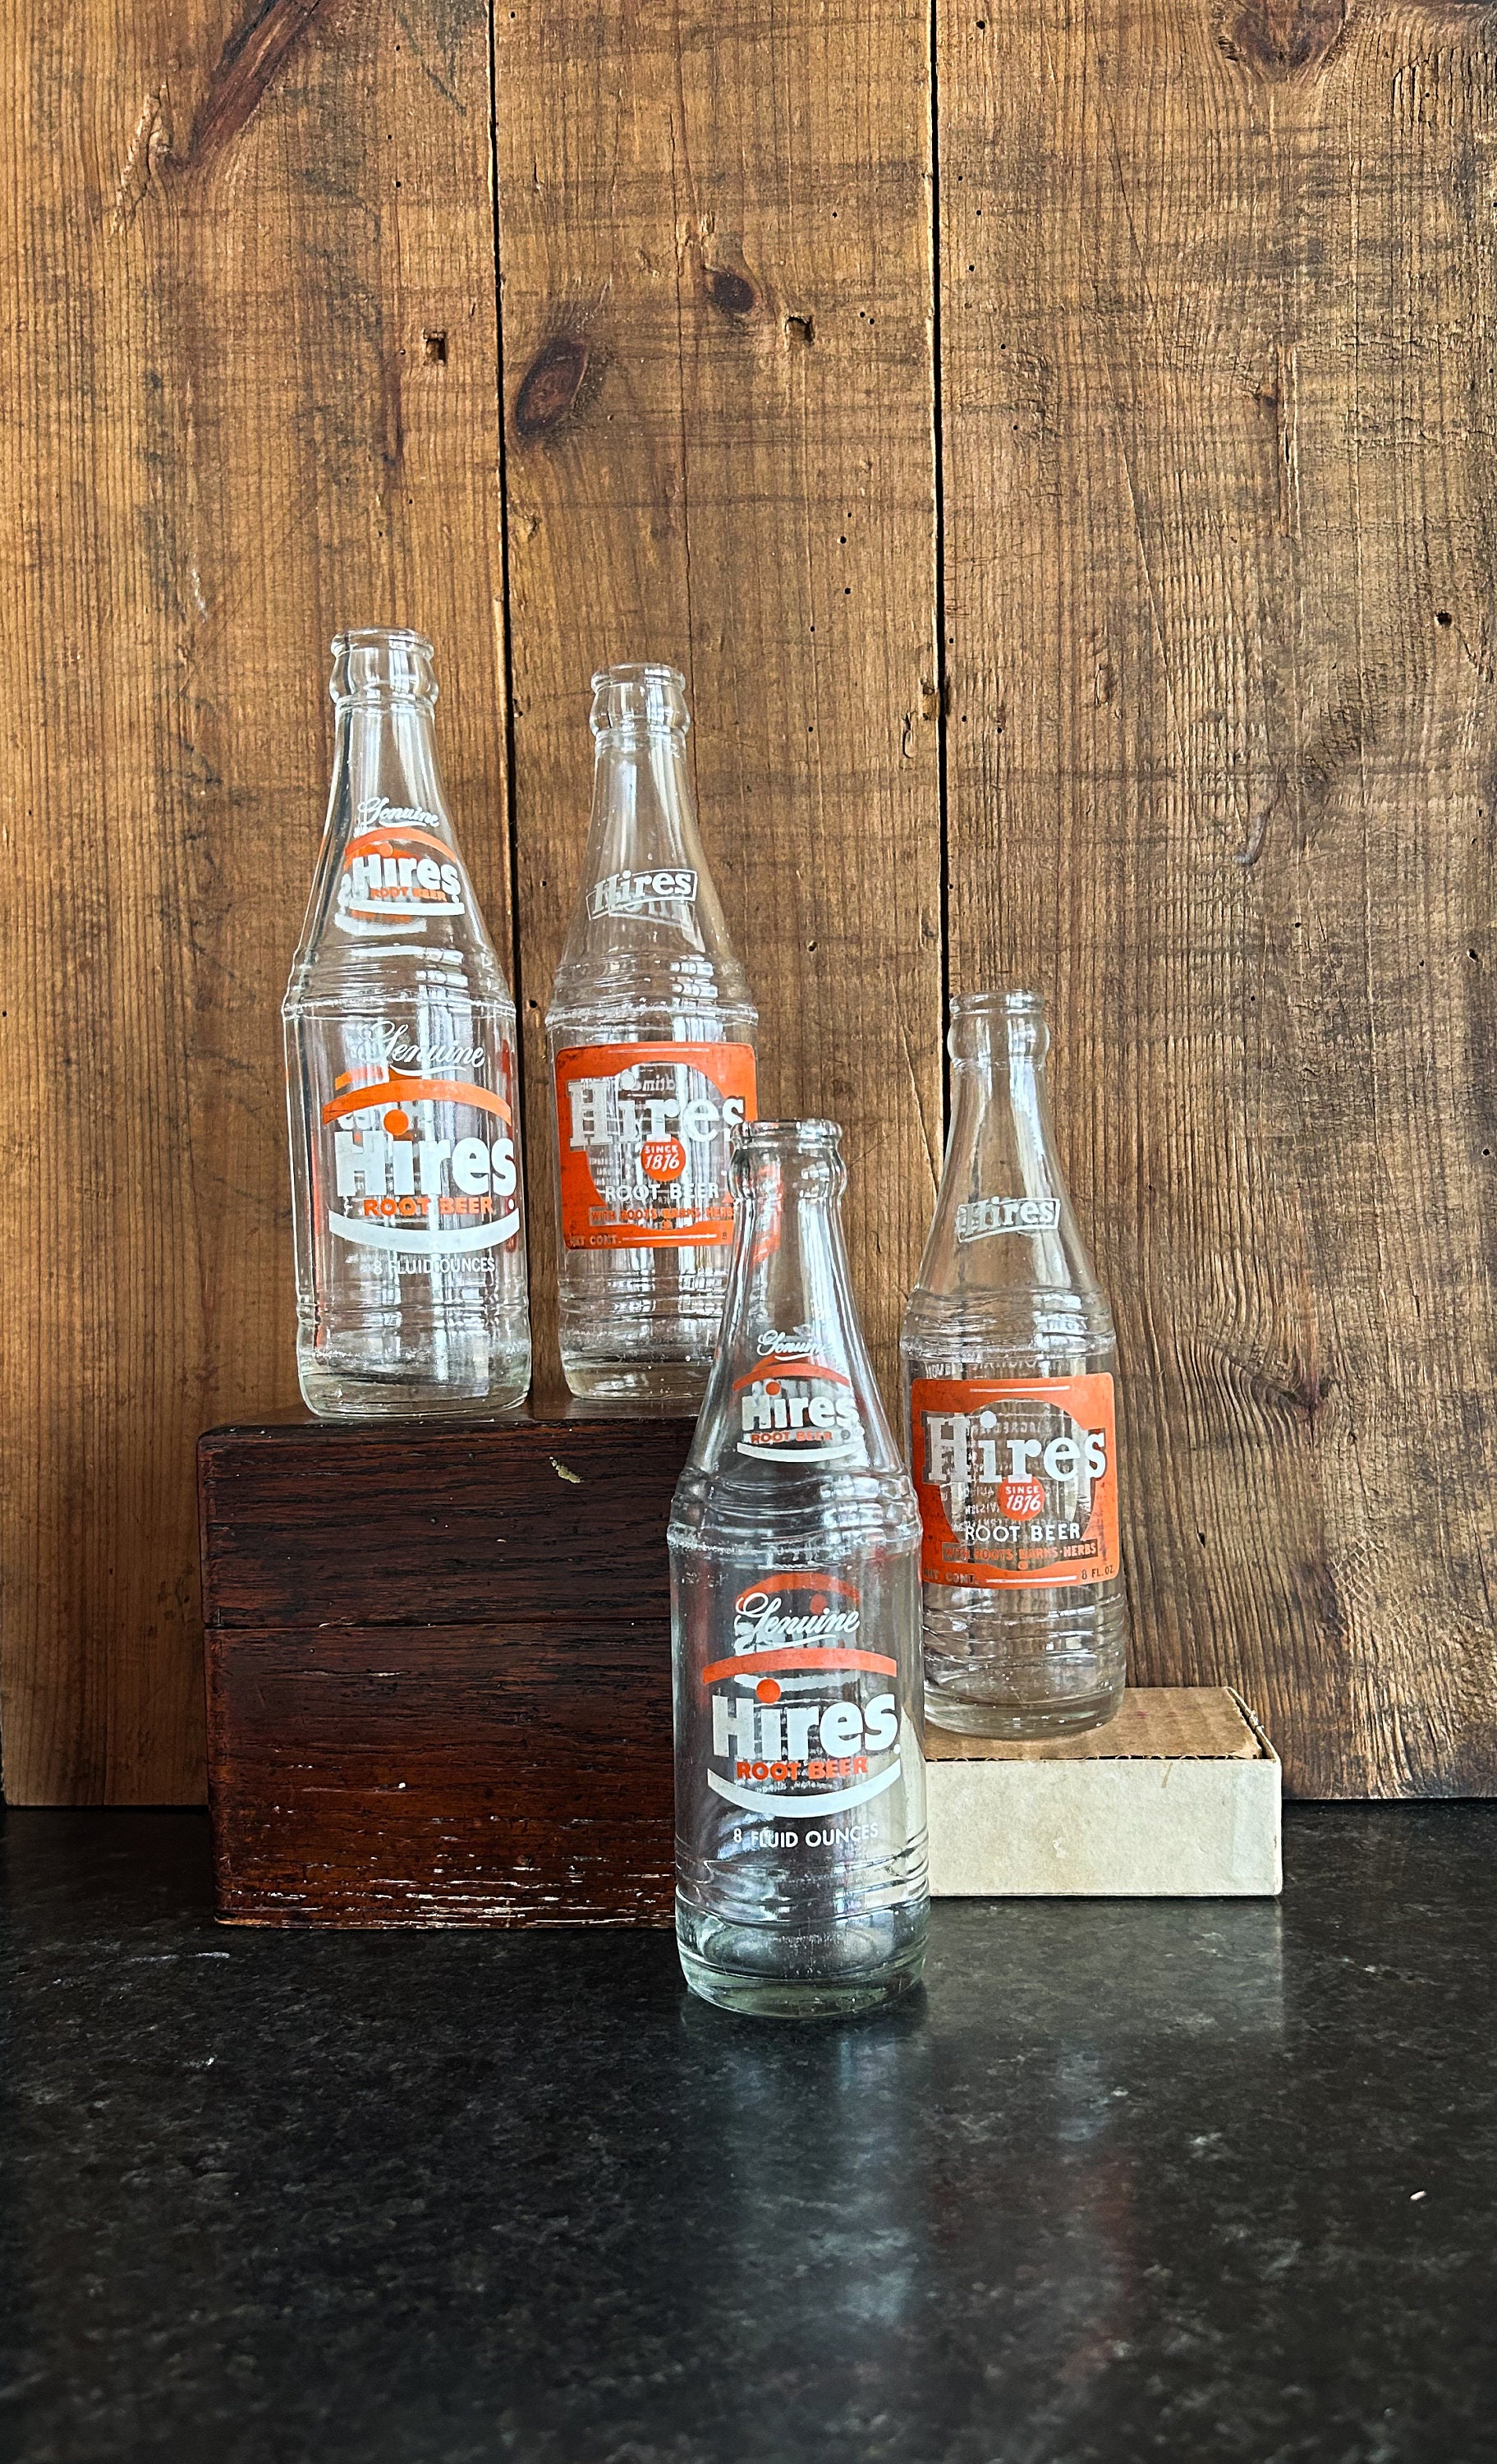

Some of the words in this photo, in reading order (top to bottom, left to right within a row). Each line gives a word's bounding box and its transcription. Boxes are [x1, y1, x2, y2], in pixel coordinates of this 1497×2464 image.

[358, 797, 439, 827] Genuine
[352, 843, 461, 895] Hires
[370, 887, 409, 899] ROOT
[412, 888, 448, 902] BEER
[592, 870, 691, 913] Hires
[365, 1020, 485, 1076] Genuine
[568, 1072, 744, 1147] Hires
[334, 1109, 517, 1197] Hires
[644, 1144, 678, 1154] SINCE
[645, 1153, 680, 1172] 1876
[605, 1184, 660, 1203] ROOT
[670, 1182, 719, 1200] BEER
[363, 1198, 431, 1216] ROOT
[439, 1198, 494, 1215] BEER
[591, 1209, 615, 1221] WITH
[708, 1206, 735, 1217] HERB
[966, 1197, 1054, 1234] Hires
[388, 1260, 434, 1275] FLUID
[440, 1257, 495, 1273] OUNCES
[742, 1381, 860, 1431] Hires
[751, 1432, 790, 1444] ROOT
[796, 1431, 833, 1441] BEER
[927, 1411, 1106, 1483] Hires
[1005, 1486, 1040, 1495] SINCE
[1007, 1495, 1041, 1515] 1876
[965, 1525, 1020, 1542] ROOT
[1031, 1523, 1080, 1541] BEER
[945, 1548, 969, 1559] WITH
[1063, 1542, 1097, 1556] HERBS
[734, 1592, 861, 1647] Genuine
[712, 1678, 898, 1761] Hires
[737, 1762, 801, 1781] ROOT
[808, 1757, 867, 1781] BEER
[733, 1828, 742, 1843] 8
[751, 1830, 798, 1848] FLUID
[805, 1823, 879, 1846] OUNCES
